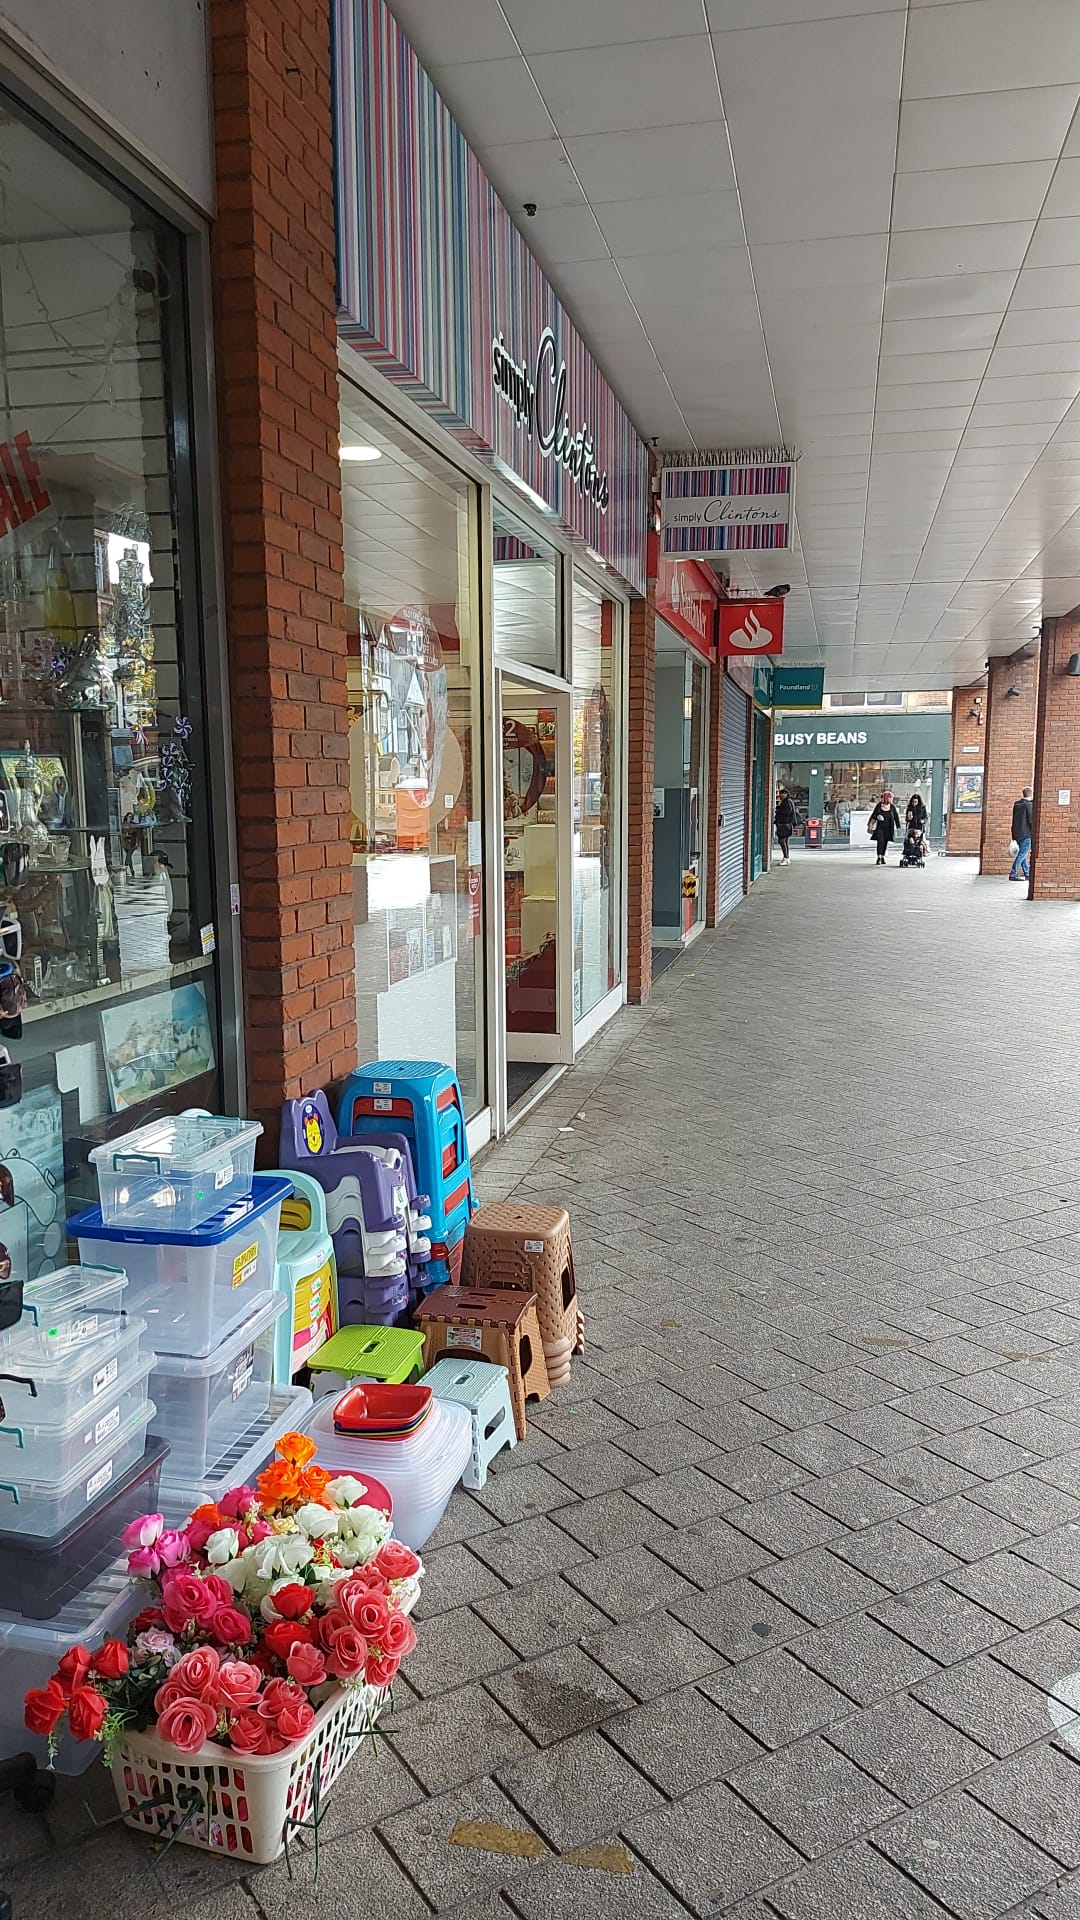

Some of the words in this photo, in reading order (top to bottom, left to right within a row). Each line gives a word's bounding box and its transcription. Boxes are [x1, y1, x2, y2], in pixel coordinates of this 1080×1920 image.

[492, 331, 535, 442] simply
[535, 326, 610, 516] Clintons
[673, 511, 702, 523] simply
[703, 499, 780, 523] Clintons
[774, 732, 815, 746] BUSY
[816, 731, 868, 745] BEANS
